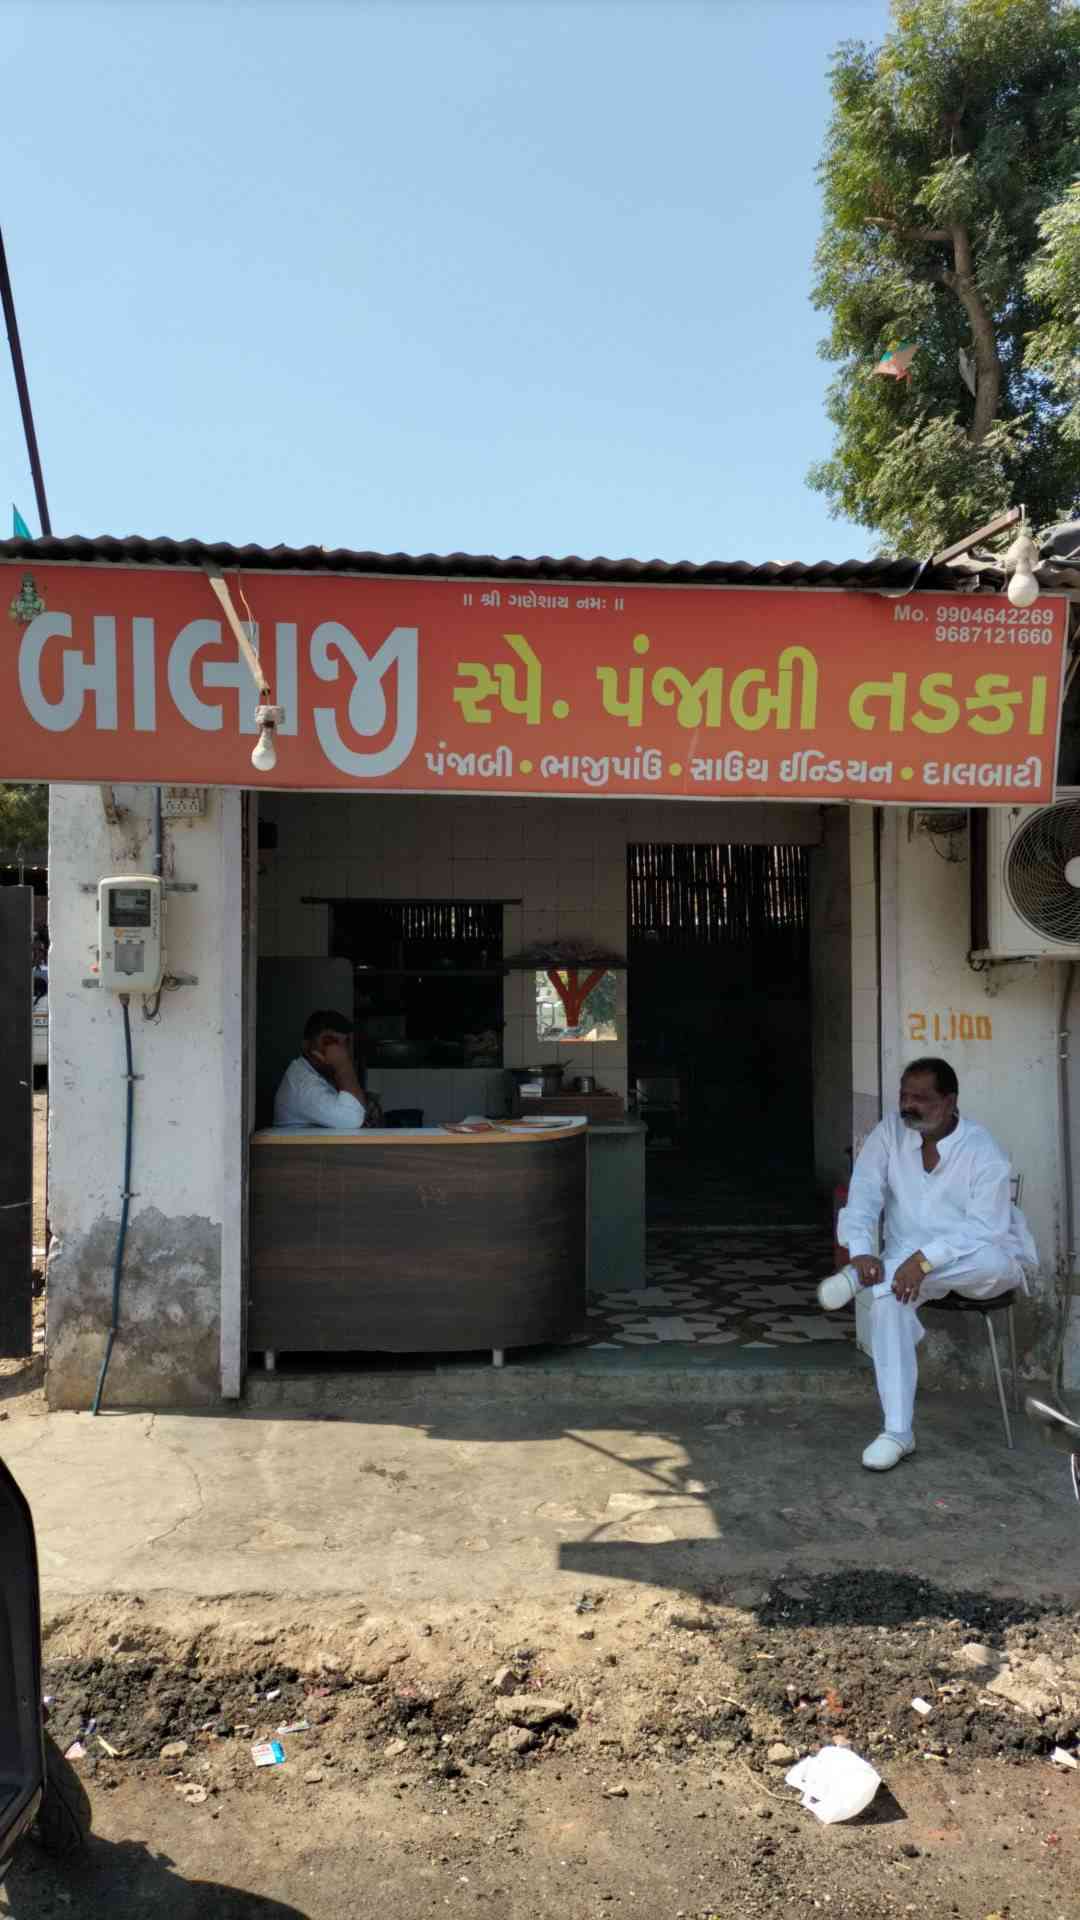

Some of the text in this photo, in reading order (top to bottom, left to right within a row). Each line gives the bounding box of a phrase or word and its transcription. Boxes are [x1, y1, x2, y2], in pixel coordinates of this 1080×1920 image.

[480, 590, 501, 608] શ્રી
[893, 604, 1055, 625] Mo. 9904642269
[934, 626, 1054, 645] 9687121660
[18, 611, 419, 778] બાલાજી
[453, 633, 1047, 736] સ્પે. પંજાબી તડકા
[424, 740, 513, 778] પંજાબી
[689, 750, 769, 782] સાઉથ
[922, 756, 1043, 788] દાલબાટી
